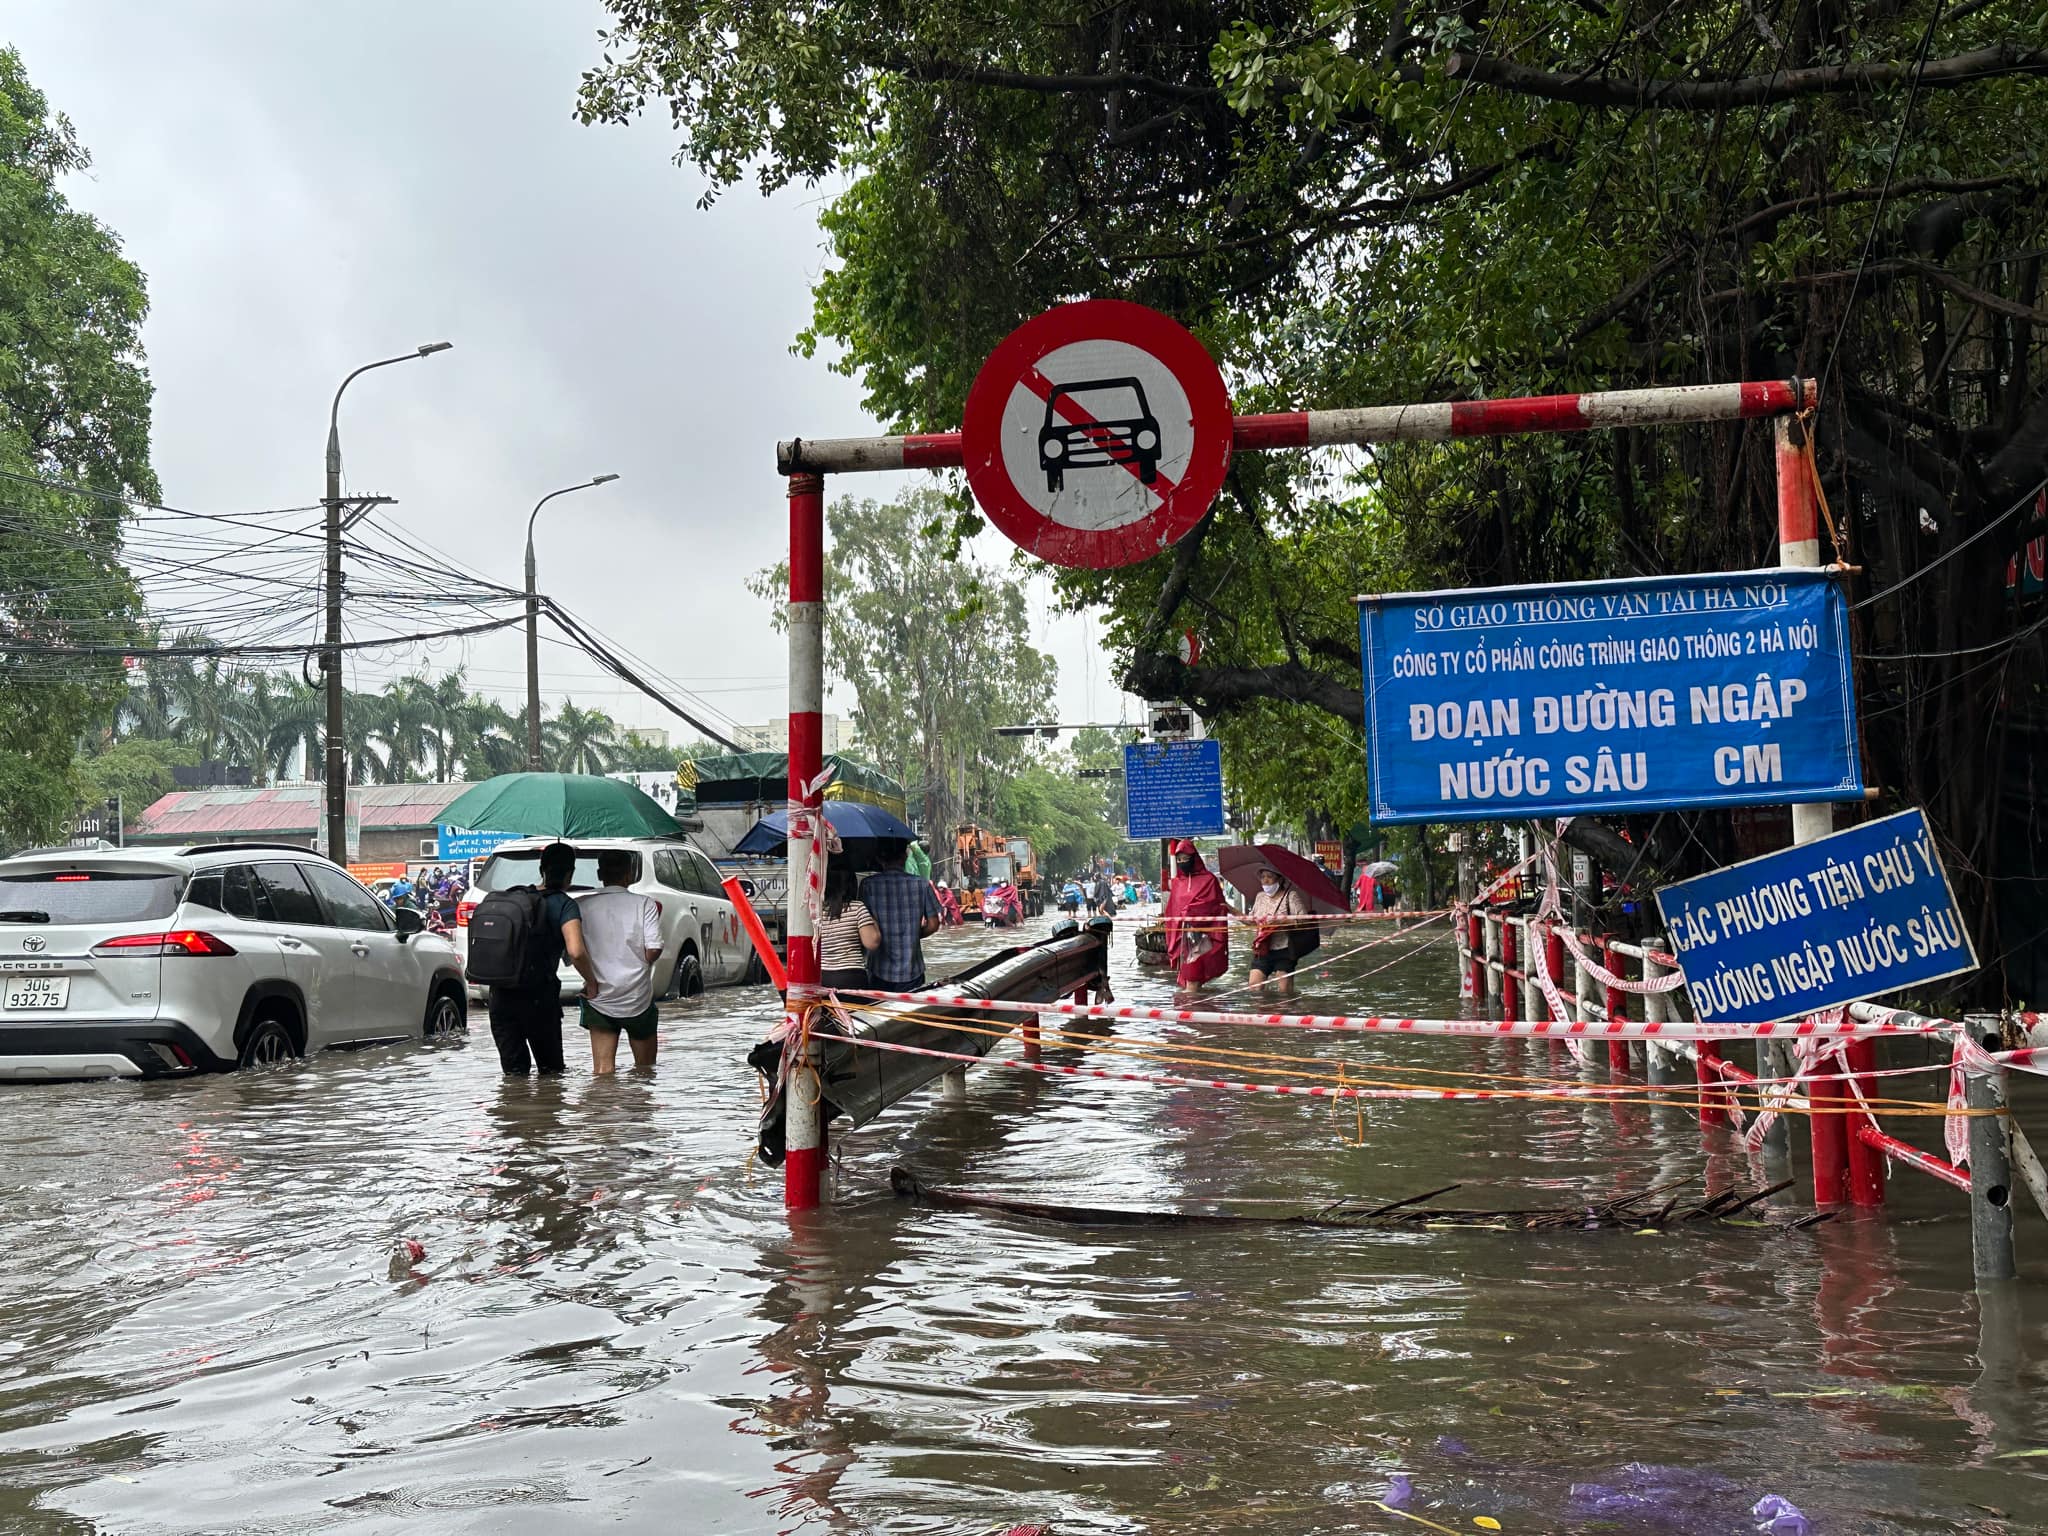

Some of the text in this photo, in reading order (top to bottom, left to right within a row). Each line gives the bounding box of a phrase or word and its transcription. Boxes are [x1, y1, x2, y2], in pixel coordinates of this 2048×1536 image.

[1450, 603, 1508, 628] GIAO
[1513, 593, 1597, 623] THÔNG
[1703, 582, 1740, 610] HÀ
[1744, 579, 1789, 611] NỘI
[1393, 618, 1818, 678] CÔNG TY CỔ PHẦN CÔNG TRÌNH GIAO THÔNG 2 HÀ NỘI
[1408, 672, 1807, 747] ĐOẠN ĐƯỜNG NGẬP
[1439, 743, 1783, 801] NƯỚC SÂU CM
[1669, 828, 1936, 952] CÁC PHƯƠNG TIỆN CHÚ Ý
[24, 979, 50, 991] 30G
[1691, 905, 1962, 1019] ĐƯỜNG NGẬP NƯỚC SÂU
[10, 993, 60, 1007] 932.75
